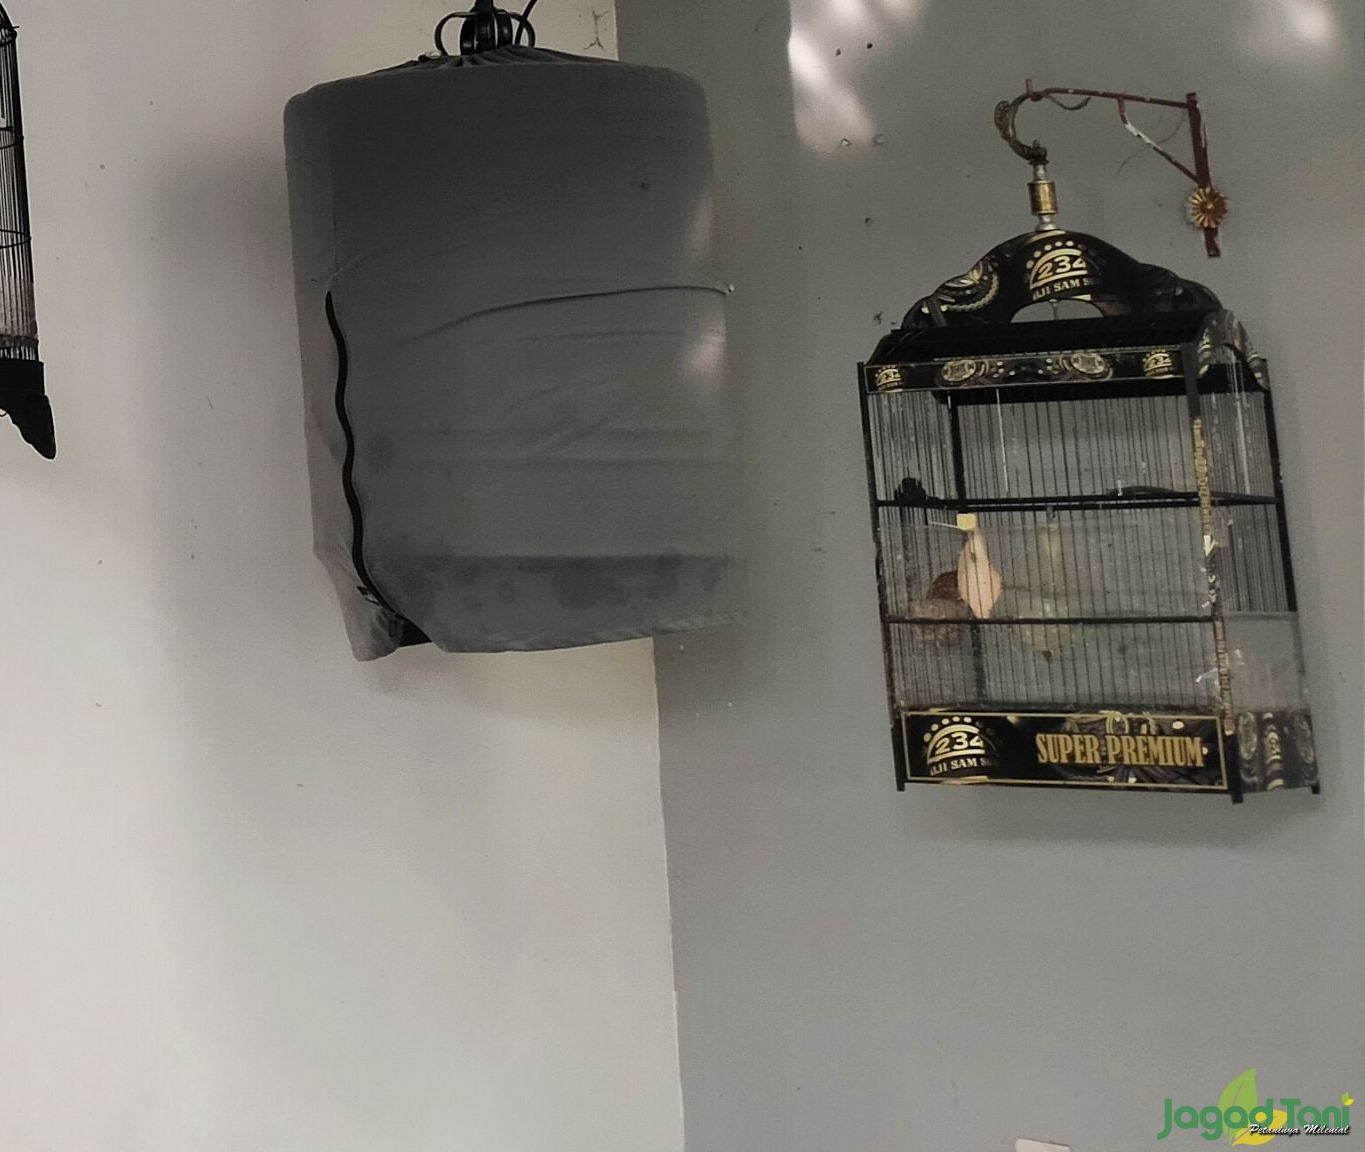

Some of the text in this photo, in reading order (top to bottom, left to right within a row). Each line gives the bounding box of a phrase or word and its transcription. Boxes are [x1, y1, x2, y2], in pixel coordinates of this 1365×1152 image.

[1053, 279, 1080, 293] SAM
[1035, 733, 1204, 767] SUPER PREMIUM
[950, 757, 978, 770] SAM
